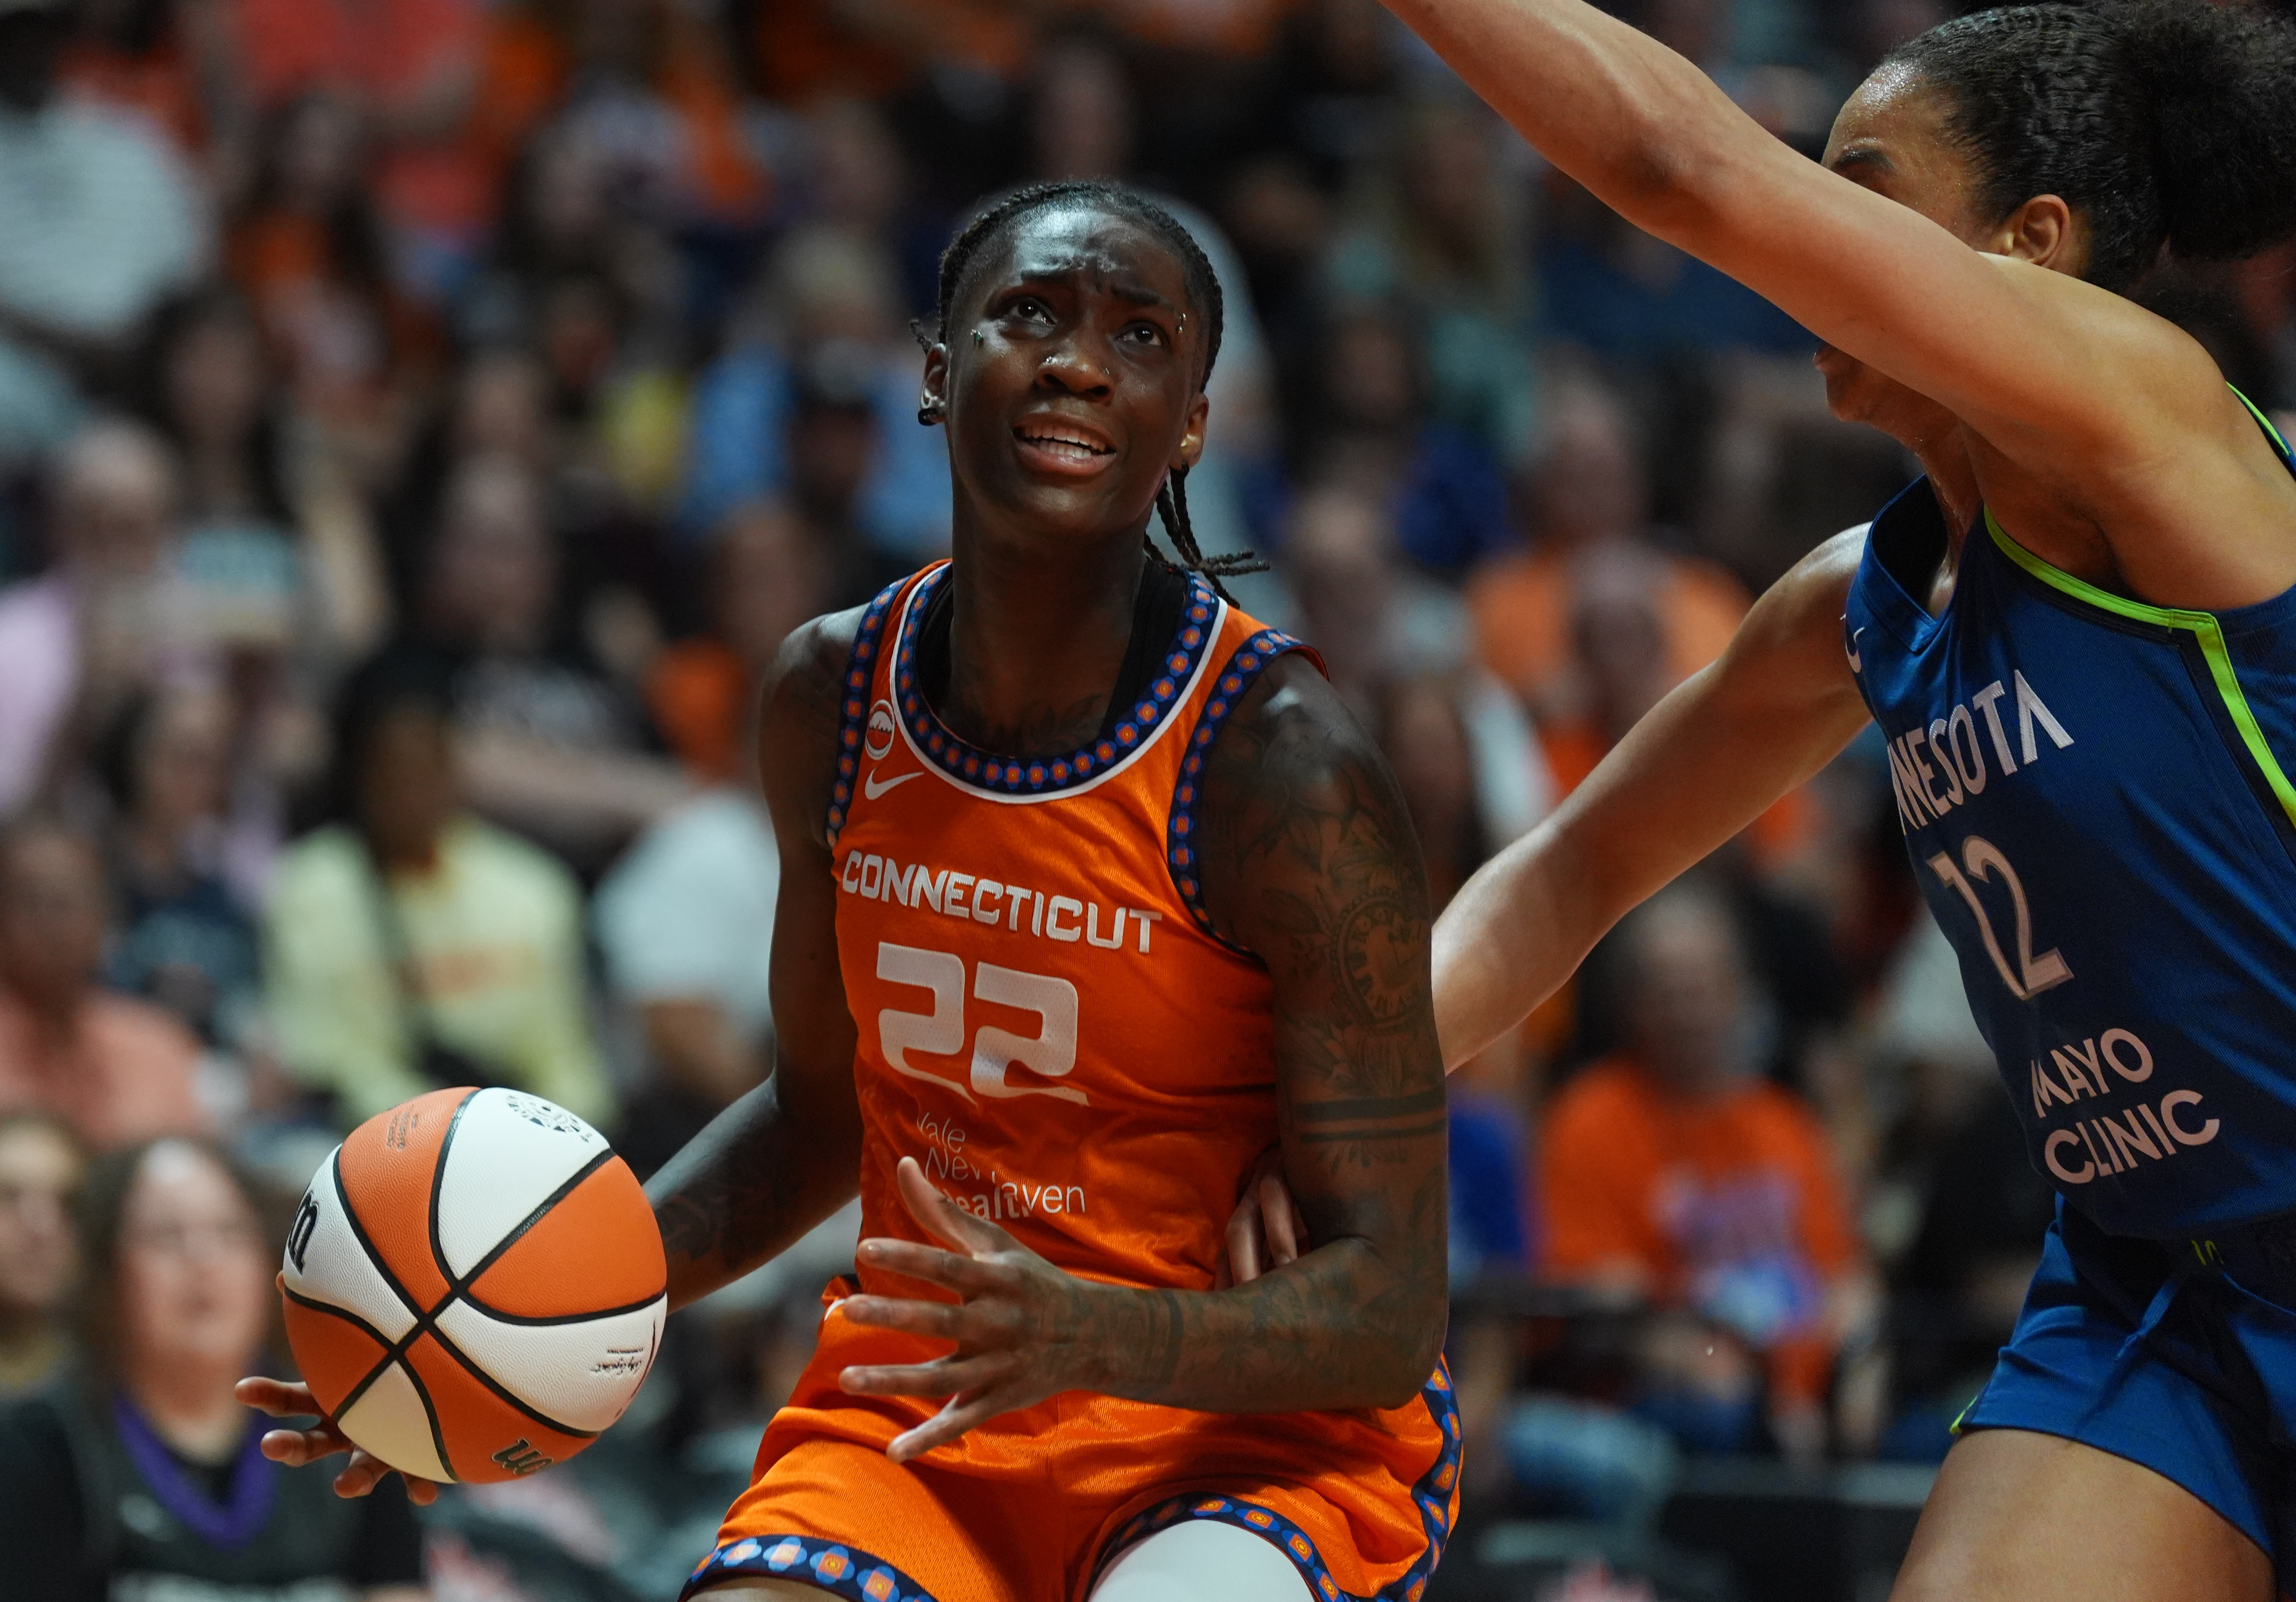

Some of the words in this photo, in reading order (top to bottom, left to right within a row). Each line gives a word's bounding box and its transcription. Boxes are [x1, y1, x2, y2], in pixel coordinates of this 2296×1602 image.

[842, 850, 1162, 953] CONNECTICUT
[1927, 835, 2075, 1001] 12
[877, 941, 1090, 1108] 22
[2031, 1028, 2153, 1119] MAYO
[2045, 1090, 2220, 1184] CLINIC
[944, 1187, 1029, 1220] ealt
[991, 1171, 1085, 1213] aven
